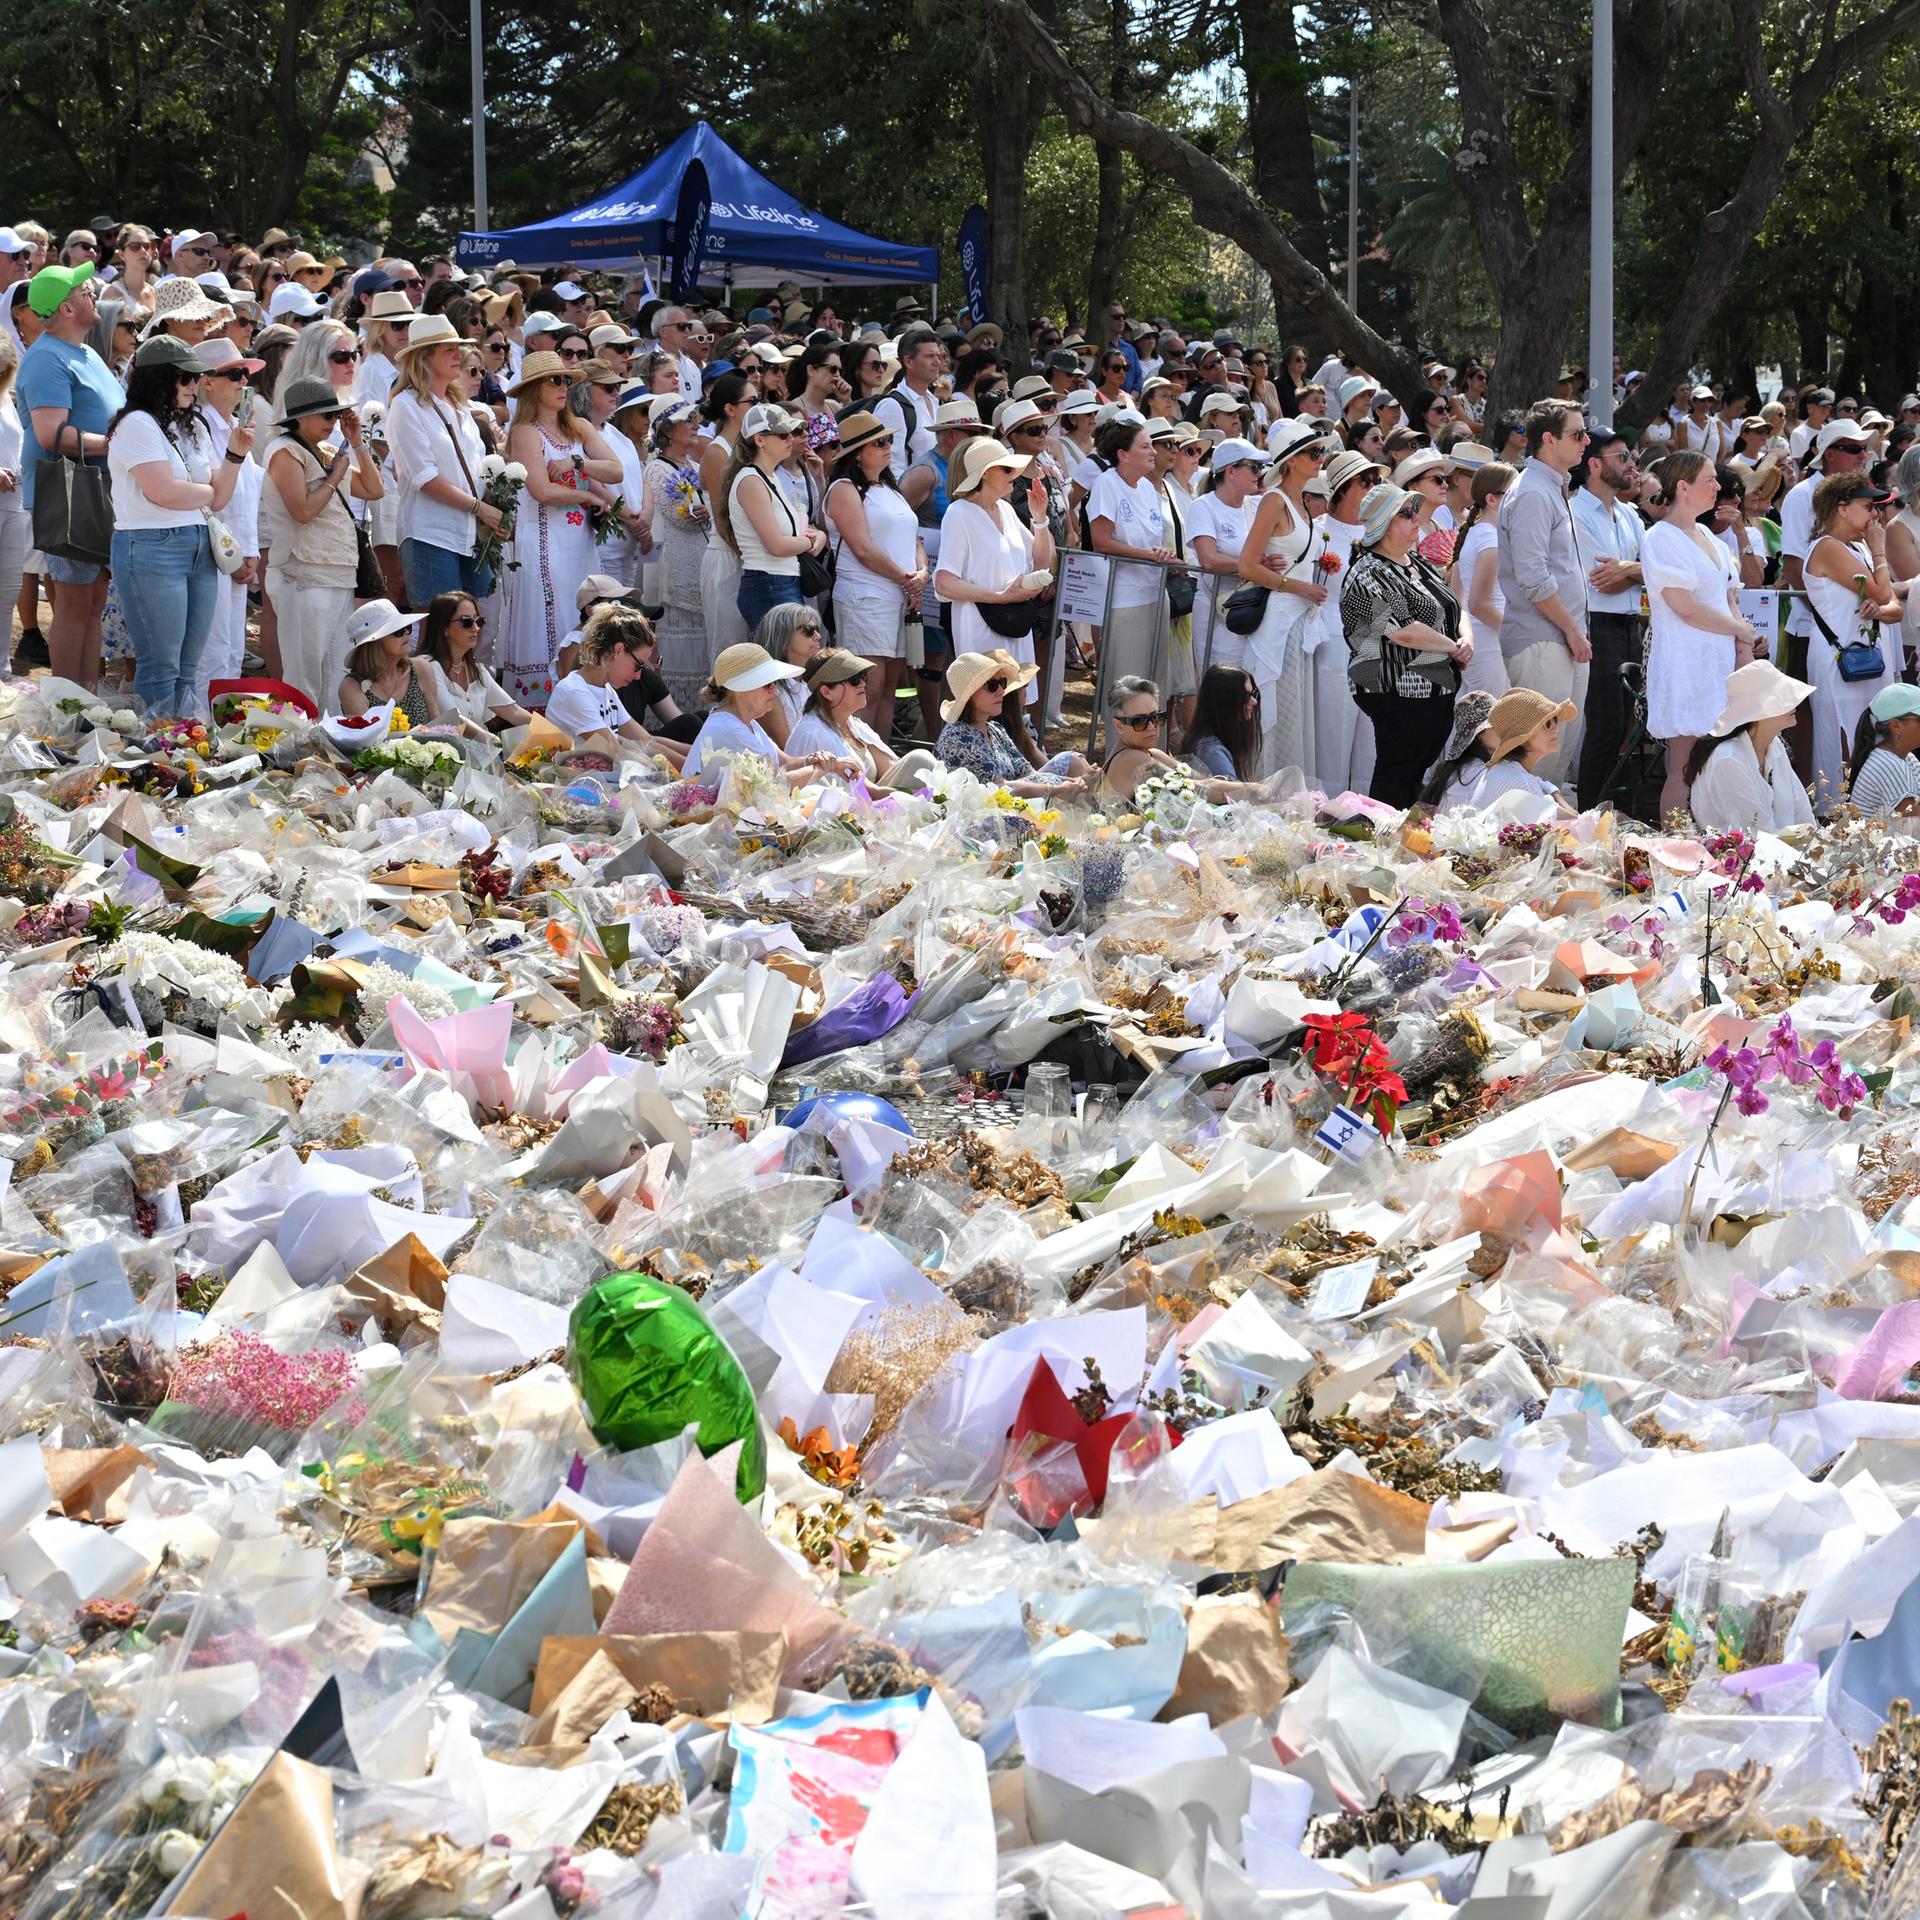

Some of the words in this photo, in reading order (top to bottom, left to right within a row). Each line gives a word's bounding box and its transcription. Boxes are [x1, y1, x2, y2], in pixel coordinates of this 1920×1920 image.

[729, 203, 819, 228] Lifeline
[469, 239, 499, 253] Lifeline
[680, 200, 706, 289] ifeline
